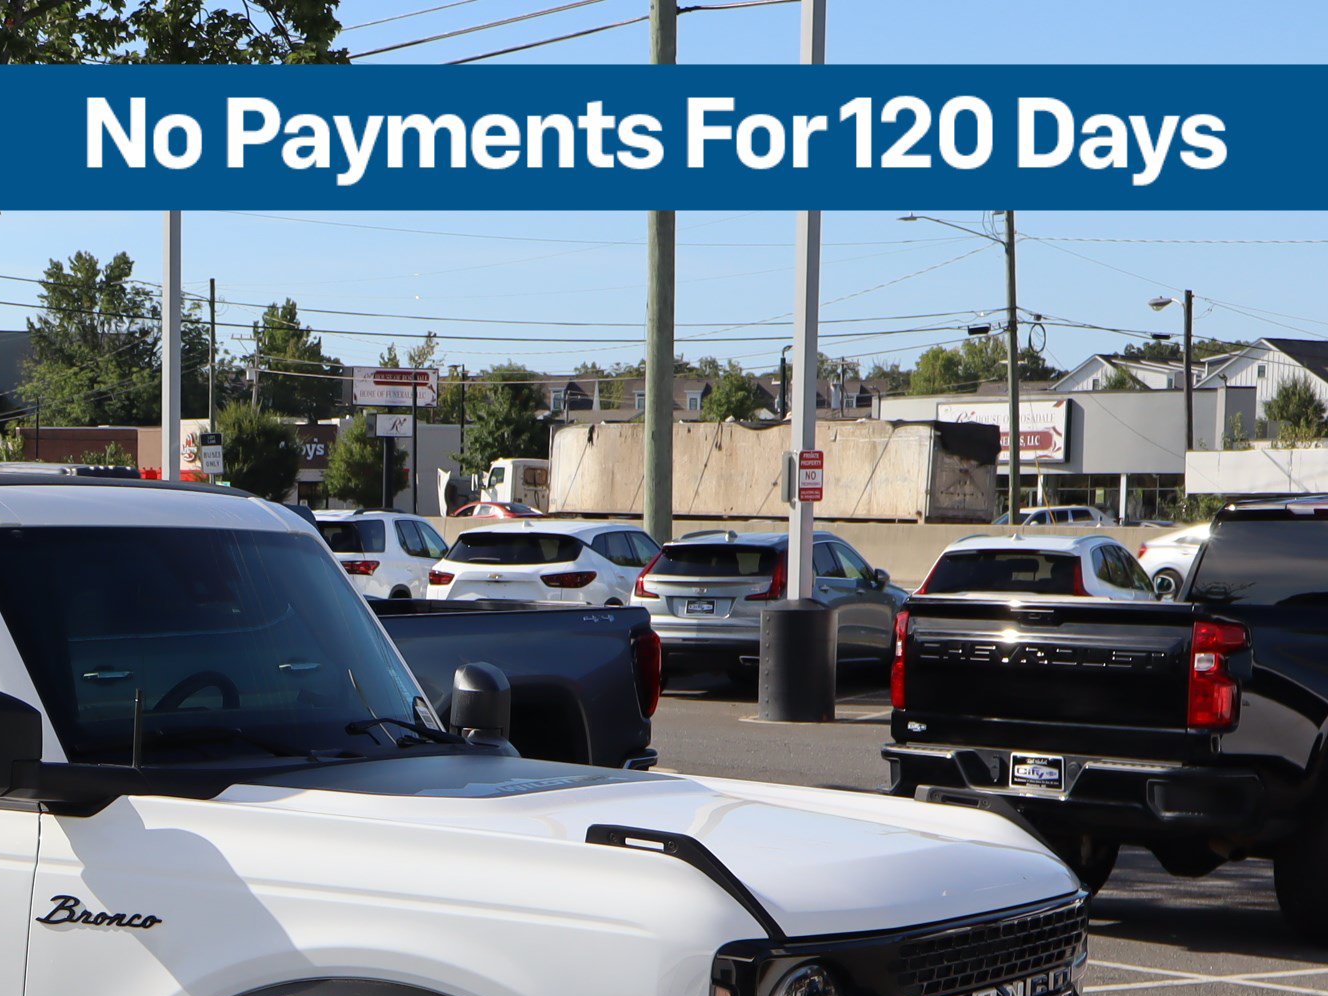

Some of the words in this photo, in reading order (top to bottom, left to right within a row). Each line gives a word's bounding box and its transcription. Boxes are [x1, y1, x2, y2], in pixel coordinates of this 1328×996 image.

[1019, 413, 1054, 425] OSADALE
[805, 471, 817, 480] NO
[35, 895, 162, 928] Bronco
